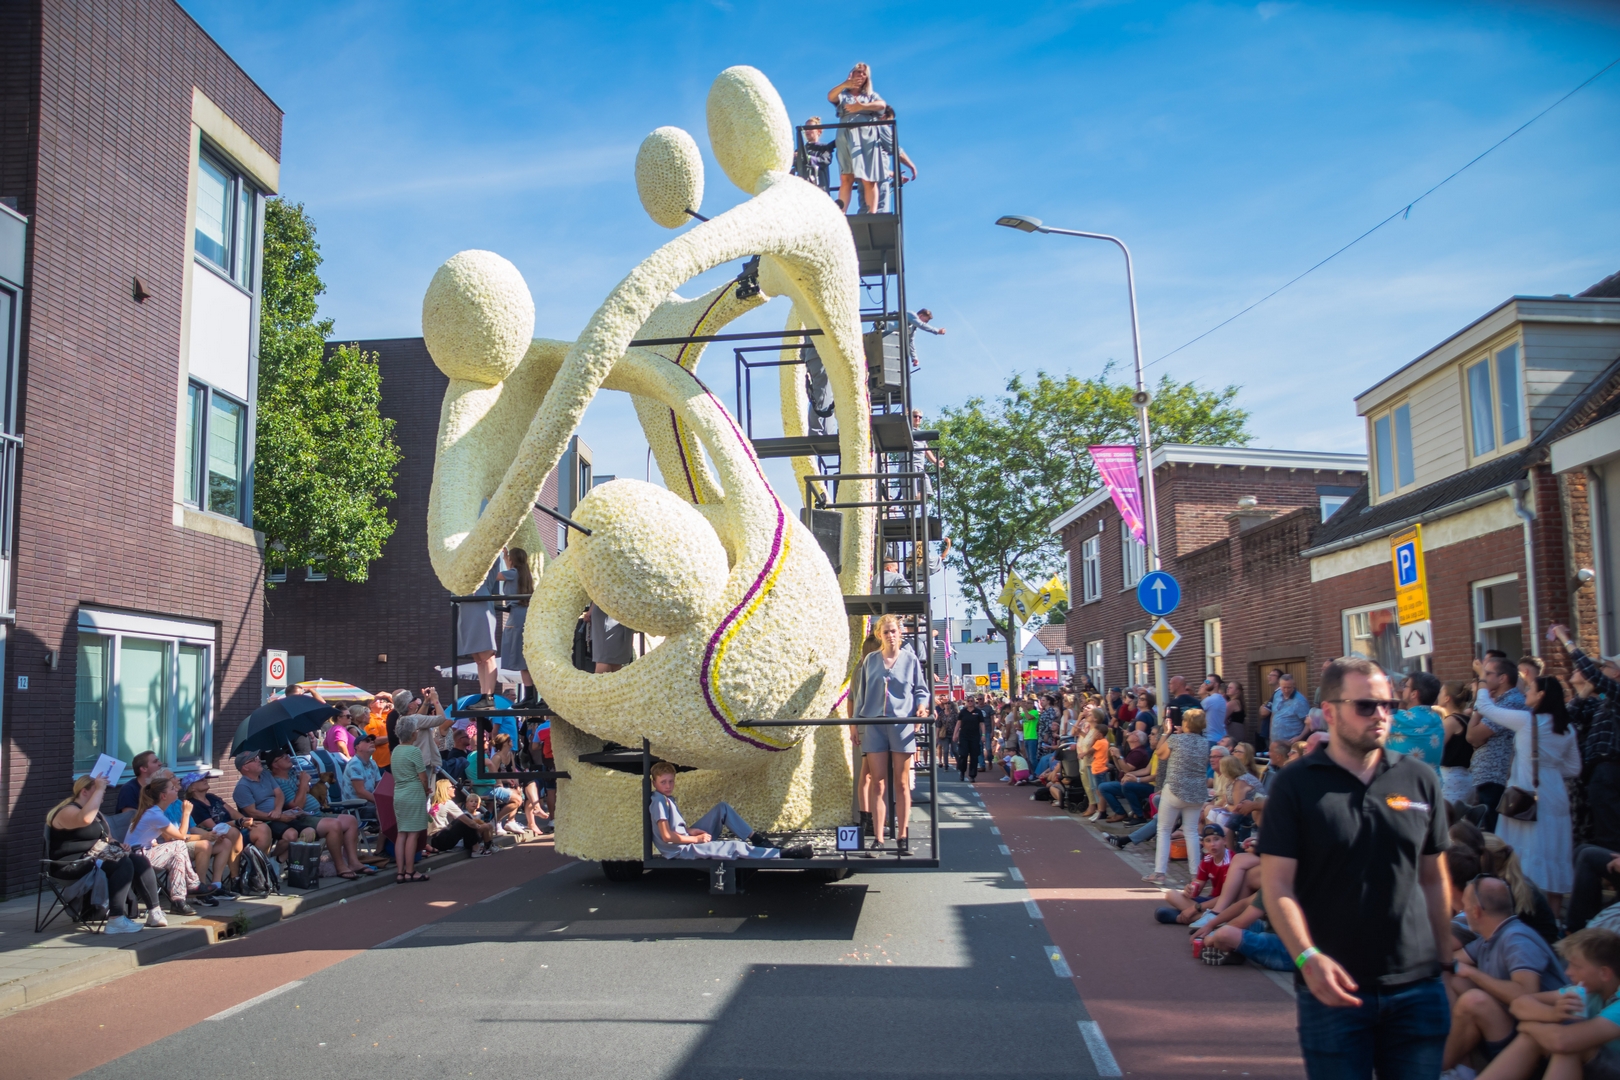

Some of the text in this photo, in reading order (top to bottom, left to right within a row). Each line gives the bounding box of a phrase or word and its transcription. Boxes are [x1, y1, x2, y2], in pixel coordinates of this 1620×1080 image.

[1400, 549, 1411, 580] P
[273, 664, 282, 673] 30
[20, 677, 26, 688] 12
[840, 829, 857, 841] 07
